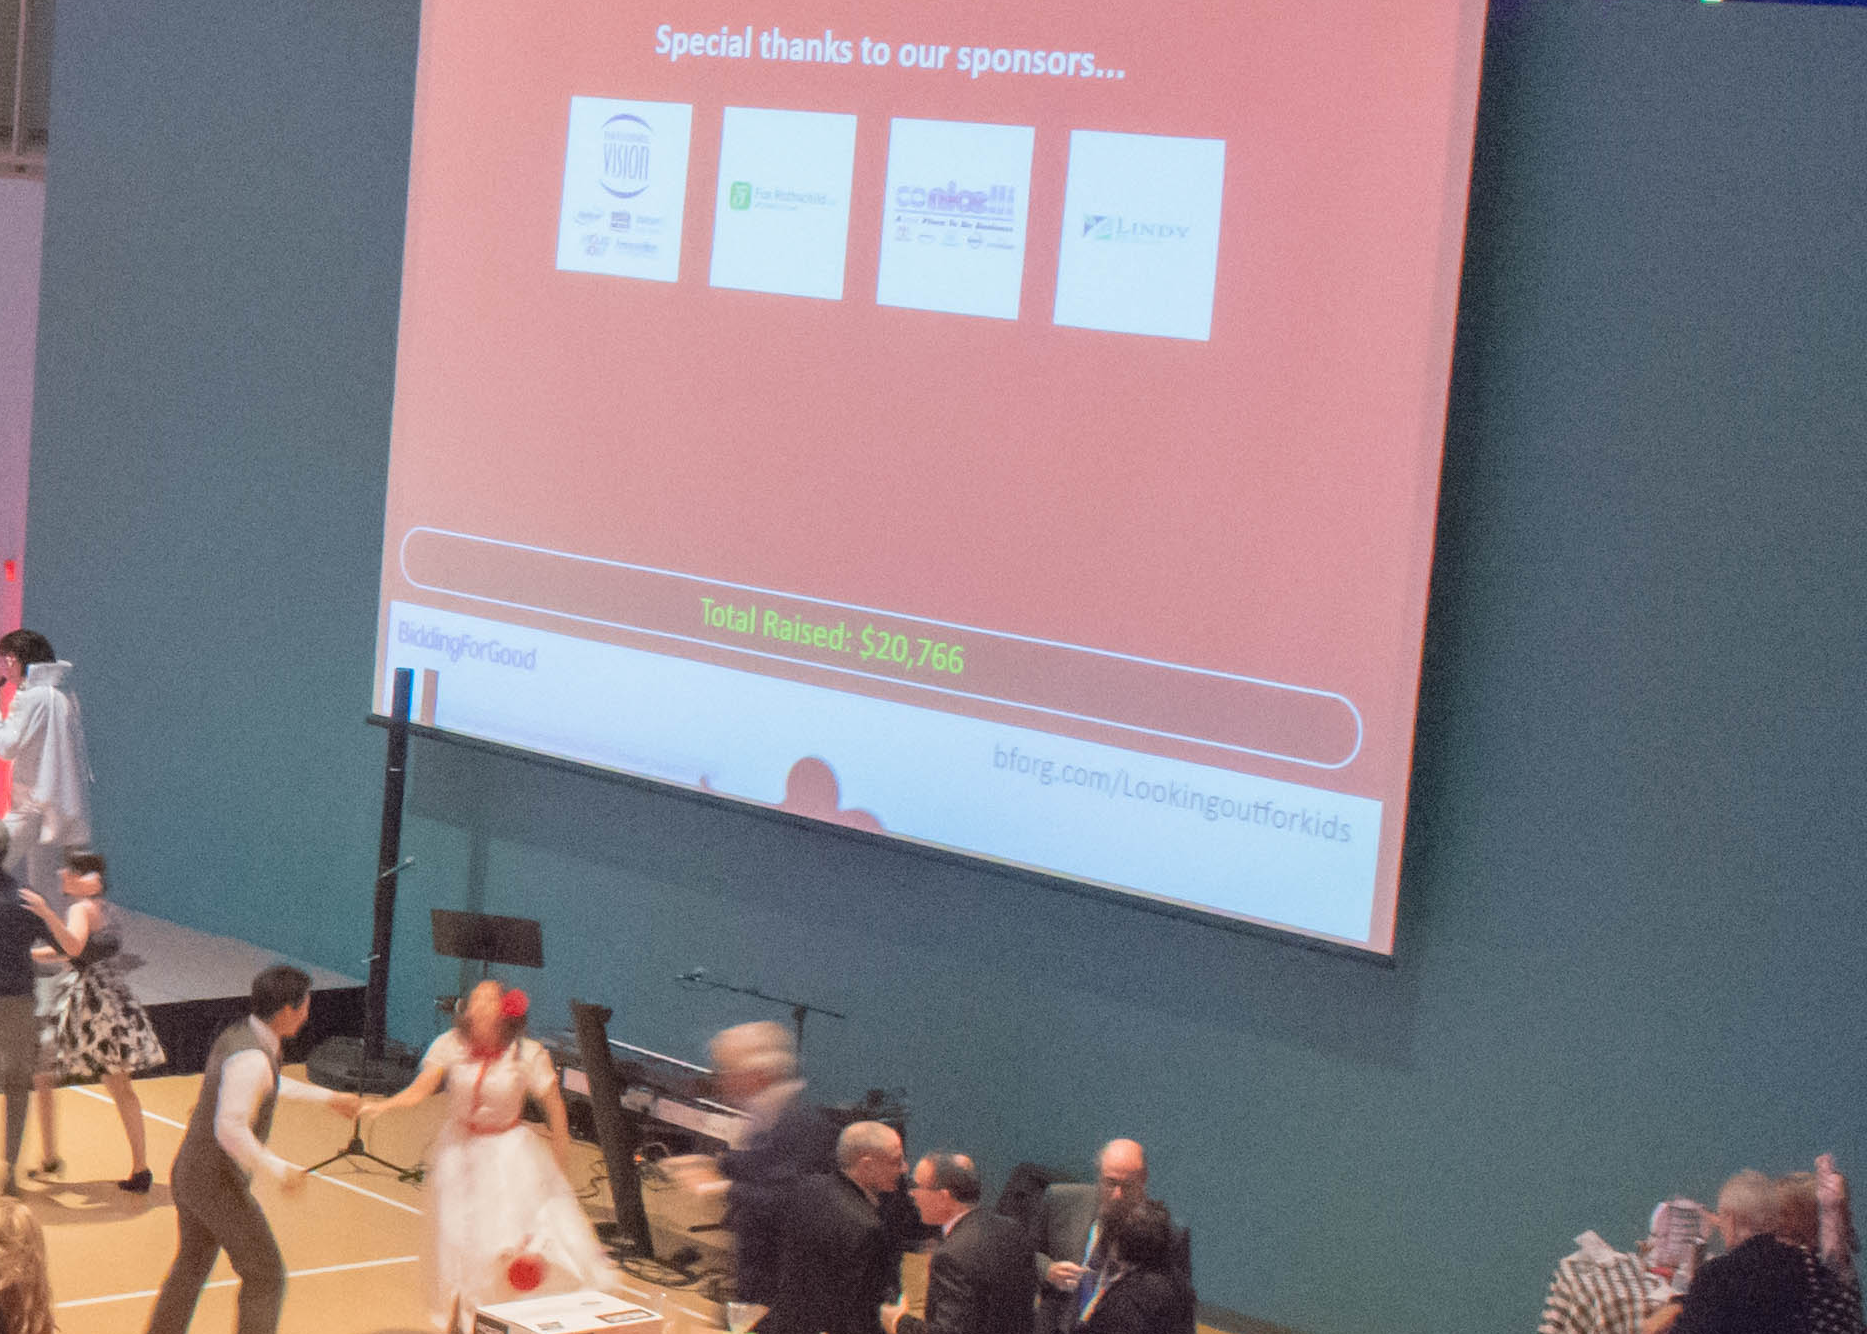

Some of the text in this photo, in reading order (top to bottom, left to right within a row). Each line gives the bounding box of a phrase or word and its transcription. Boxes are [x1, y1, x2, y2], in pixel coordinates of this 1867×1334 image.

[656, 25, 1126, 80] Special thanks to our sponsors...
[604, 143, 650, 181] VISION
[1117, 217, 1190, 239] LINDY
[397, 620, 537, 671] BiddingForGood
[701, 598, 965, 675] Total Raised: $20,766
[993, 743, 1352, 844] bforg.com/Lookingoutforkids
